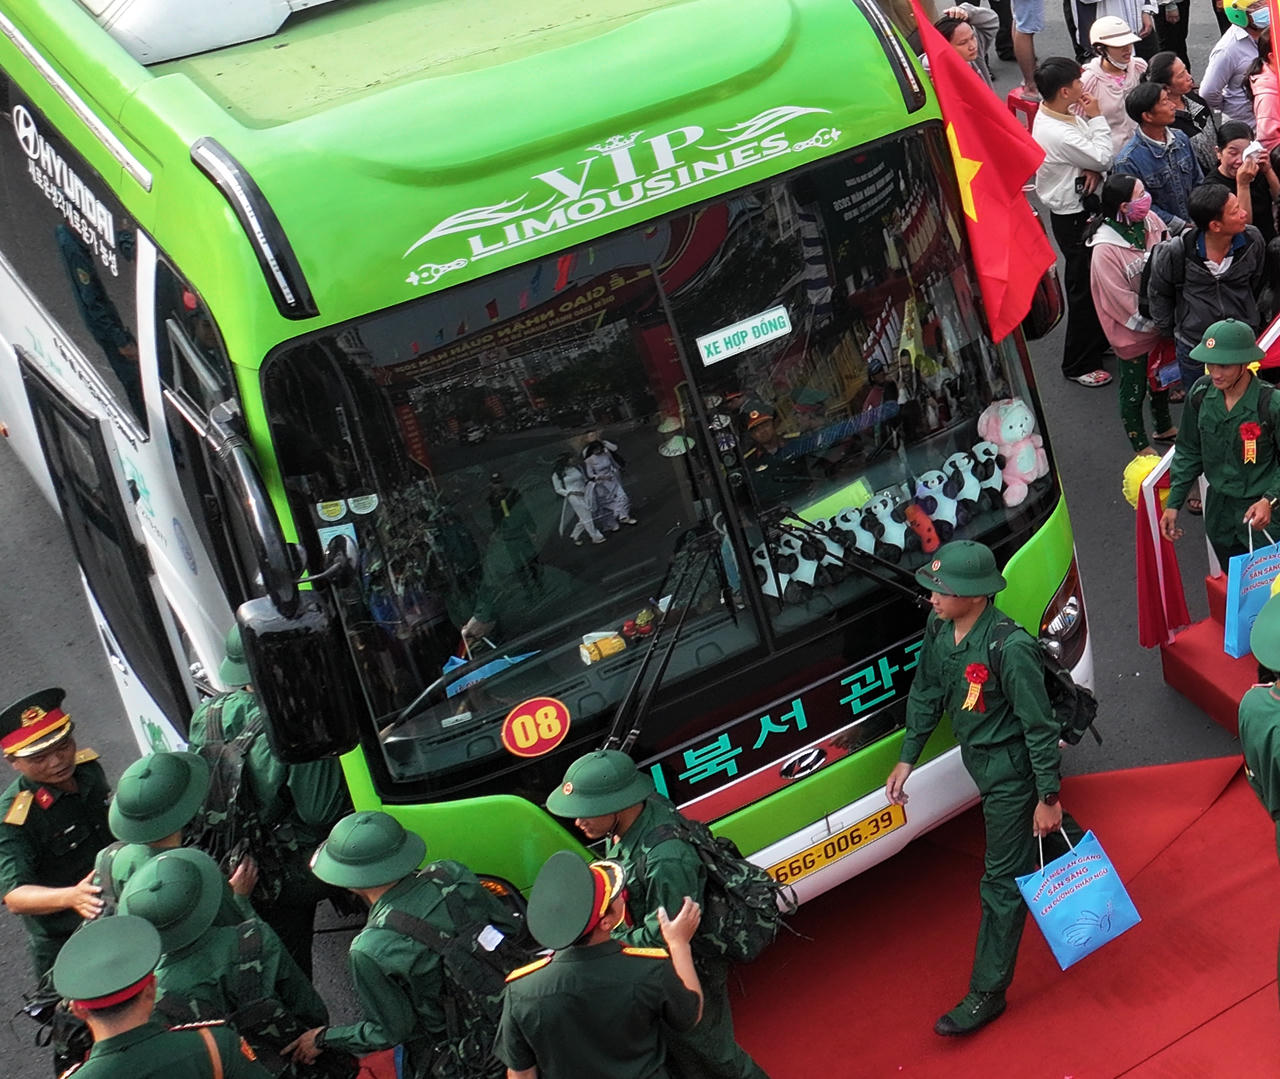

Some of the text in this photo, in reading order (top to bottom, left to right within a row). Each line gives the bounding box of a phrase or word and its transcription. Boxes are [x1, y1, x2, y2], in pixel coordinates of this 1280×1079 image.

[38, 135, 116, 249] HYUNDAI
[467, 132, 791, 257] LIMOUSINES
[531, 125, 705, 201] VIP
[703, 315, 787, 359] XE HỢP ĐỒNG
[511, 705, 562, 750] 08
[650, 698, 808, 800] 북서
[775, 811, 893, 884] 66G-006.39
[1033, 853, 1102, 903] THANH NIÊN AN GIANG
